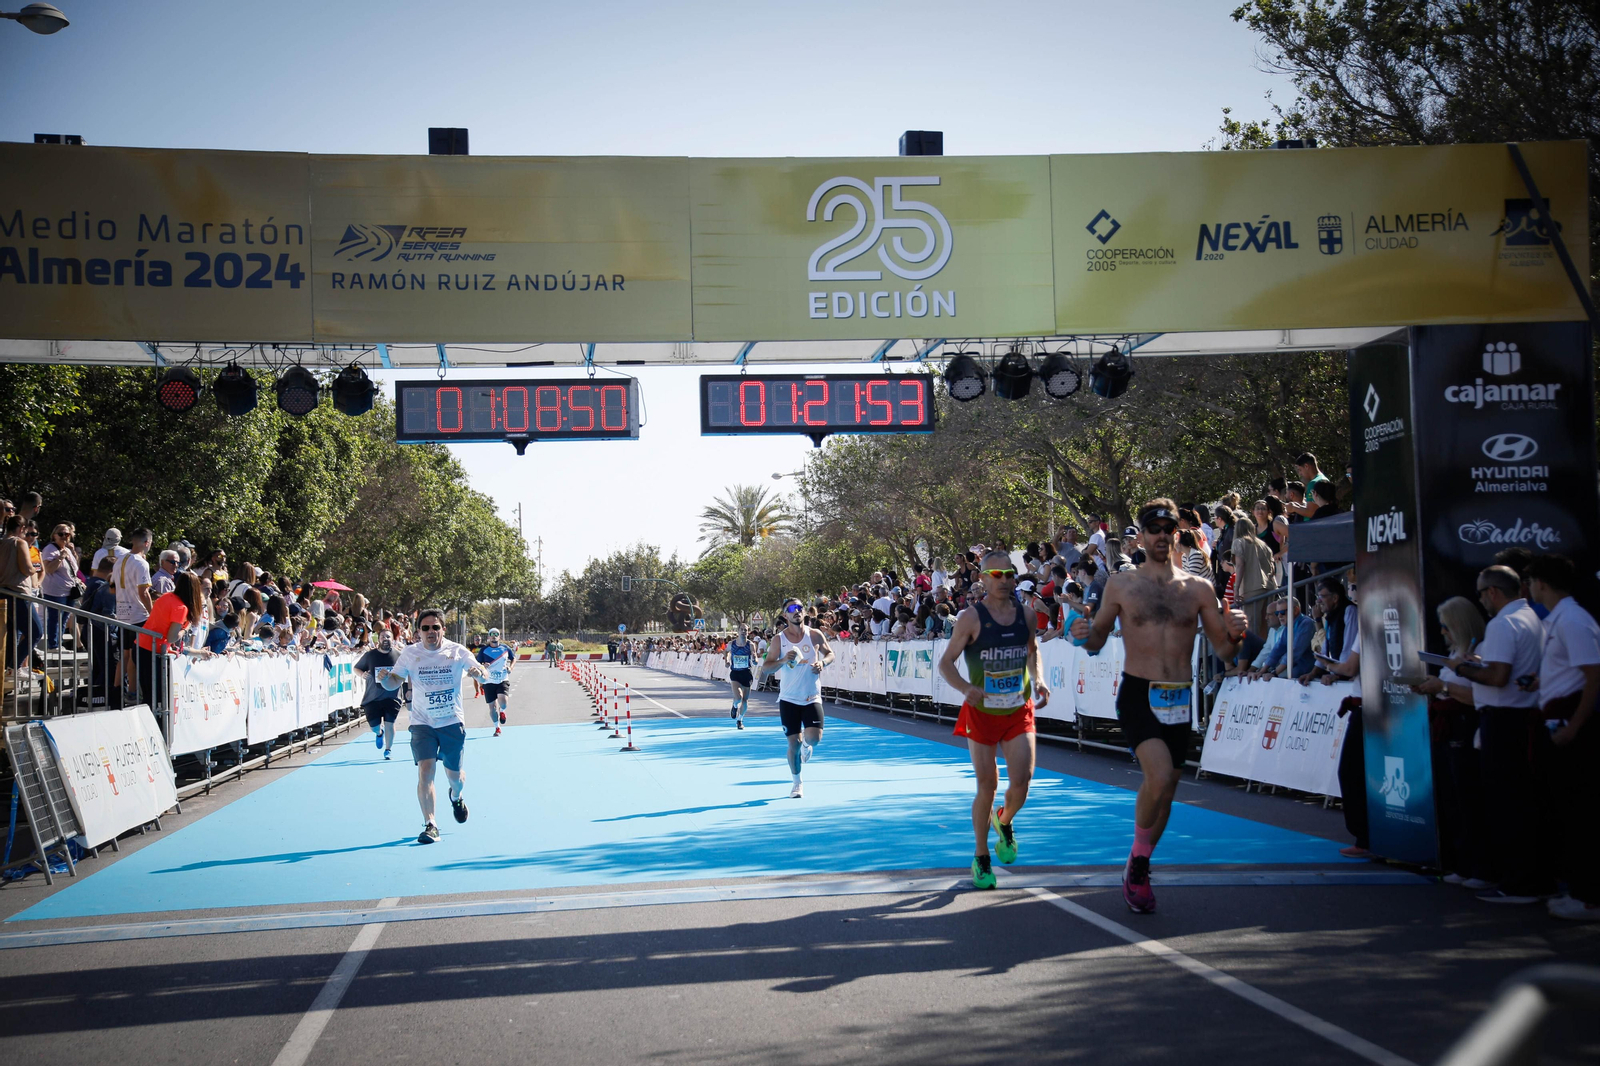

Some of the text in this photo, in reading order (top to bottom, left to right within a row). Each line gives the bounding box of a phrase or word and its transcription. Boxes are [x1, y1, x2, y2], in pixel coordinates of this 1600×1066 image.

[0, 209, 304, 245] Medio Maratón
[806, 175, 954, 281] 25
[1364, 208, 1470, 235] ALMERÍA
[405, 226, 468, 239] RFEA
[401, 241, 462, 253] SERIES
[1364, 236, 1419, 251] CIUDAD
[397, 252, 497, 263] RUTA RUNNING
[1086, 246, 1175, 261] COOPERACIÓN
[1203, 252, 1225, 261] 2020
[0, 246, 306, 289] Almería 2024
[1086, 260, 1117, 272] 2005
[331, 269, 626, 292] RAMÓN RUIZ ANDÚJAR
[808, 283, 957, 320] EDICIÓN
[1444, 377, 1562, 410] cajamar
[1470, 465, 1550, 479] HYUNDAI
[1474, 480, 1548, 493] Almerialva
[989, 675, 1020, 690] 1662
[429, 694, 453, 705] 5436
[1289, 708, 1338, 736] ALMERÍA
